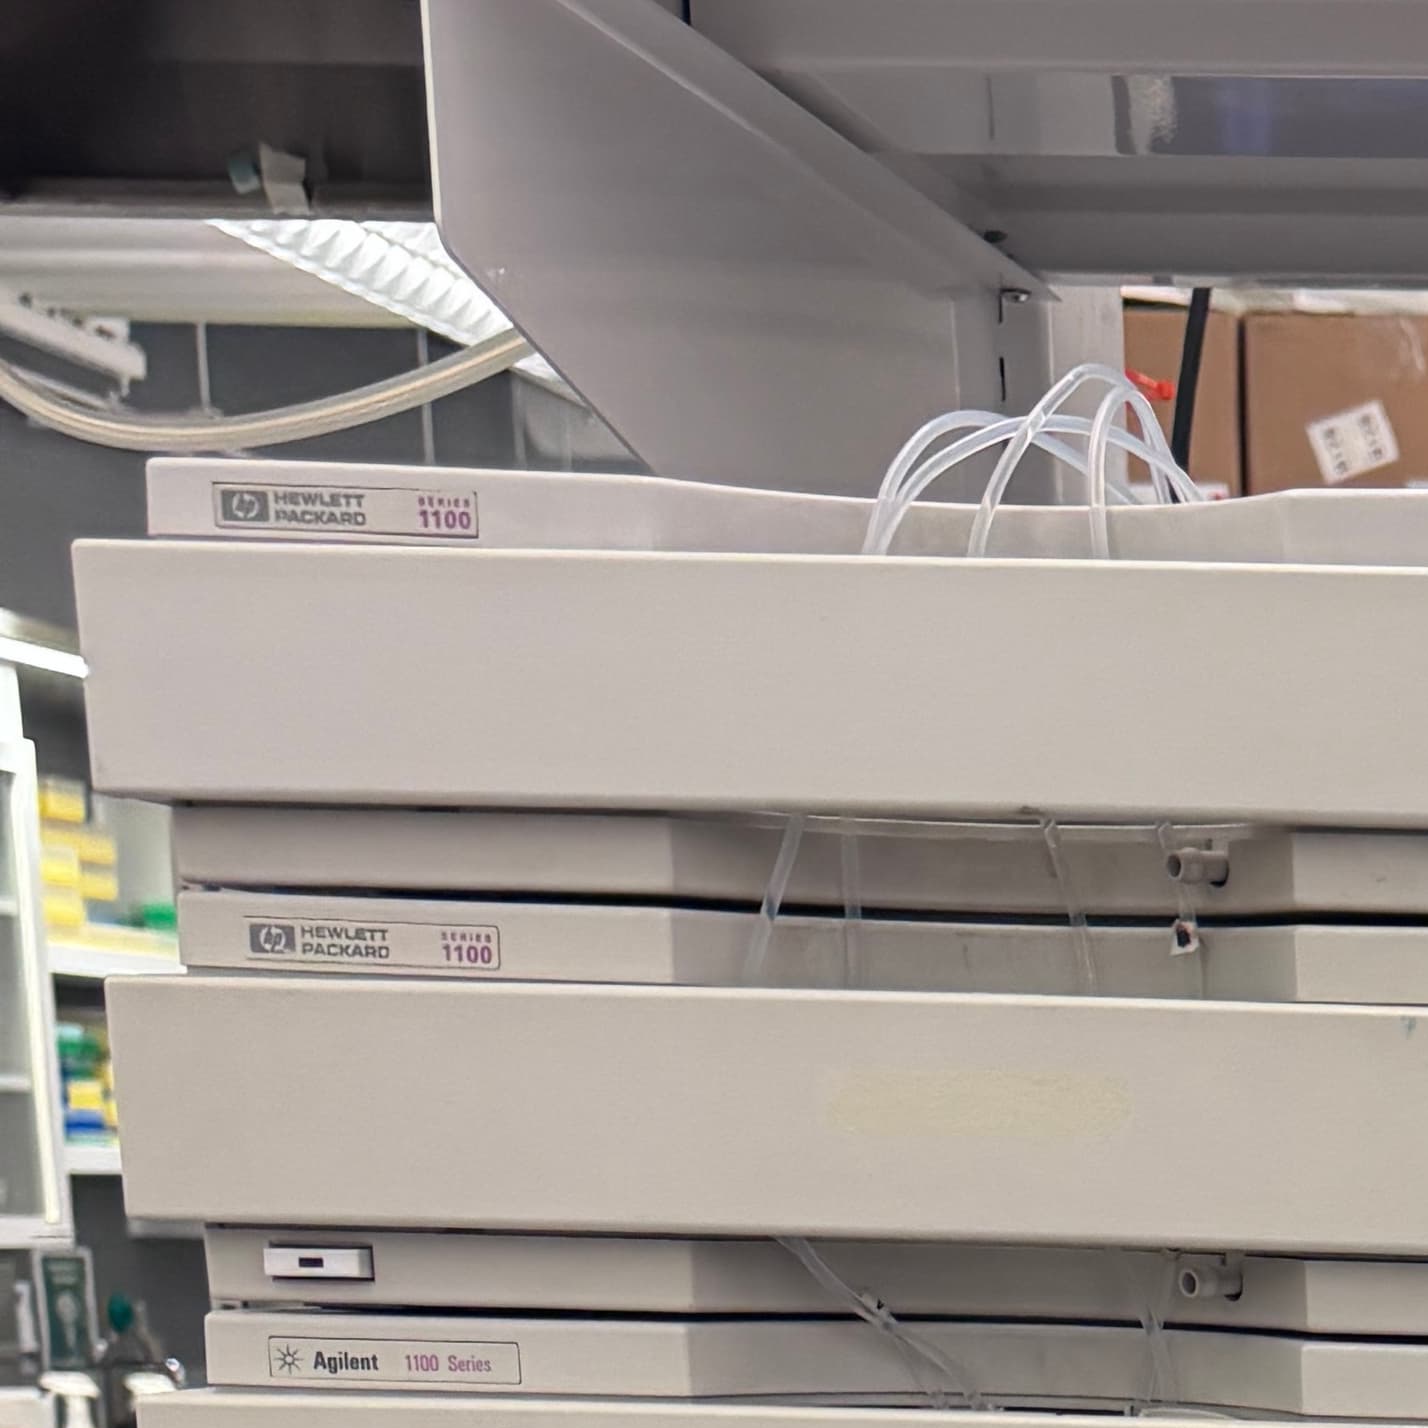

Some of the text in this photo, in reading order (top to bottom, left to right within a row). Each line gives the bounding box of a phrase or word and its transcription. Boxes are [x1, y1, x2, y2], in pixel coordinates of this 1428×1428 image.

[274, 490, 365, 509] HEWLETT
[417, 496, 471, 508] SERIES
[274, 508, 366, 526] PACKARD
[418, 510, 471, 530] 1100
[301, 926, 388, 942] HEWLETT
[441, 931, 492, 943] SERIES
[301, 943, 389, 959] PACKARD
[442, 944, 492, 964] 1100
[313, 1351, 492, 1374] Agilent 1100 Series
